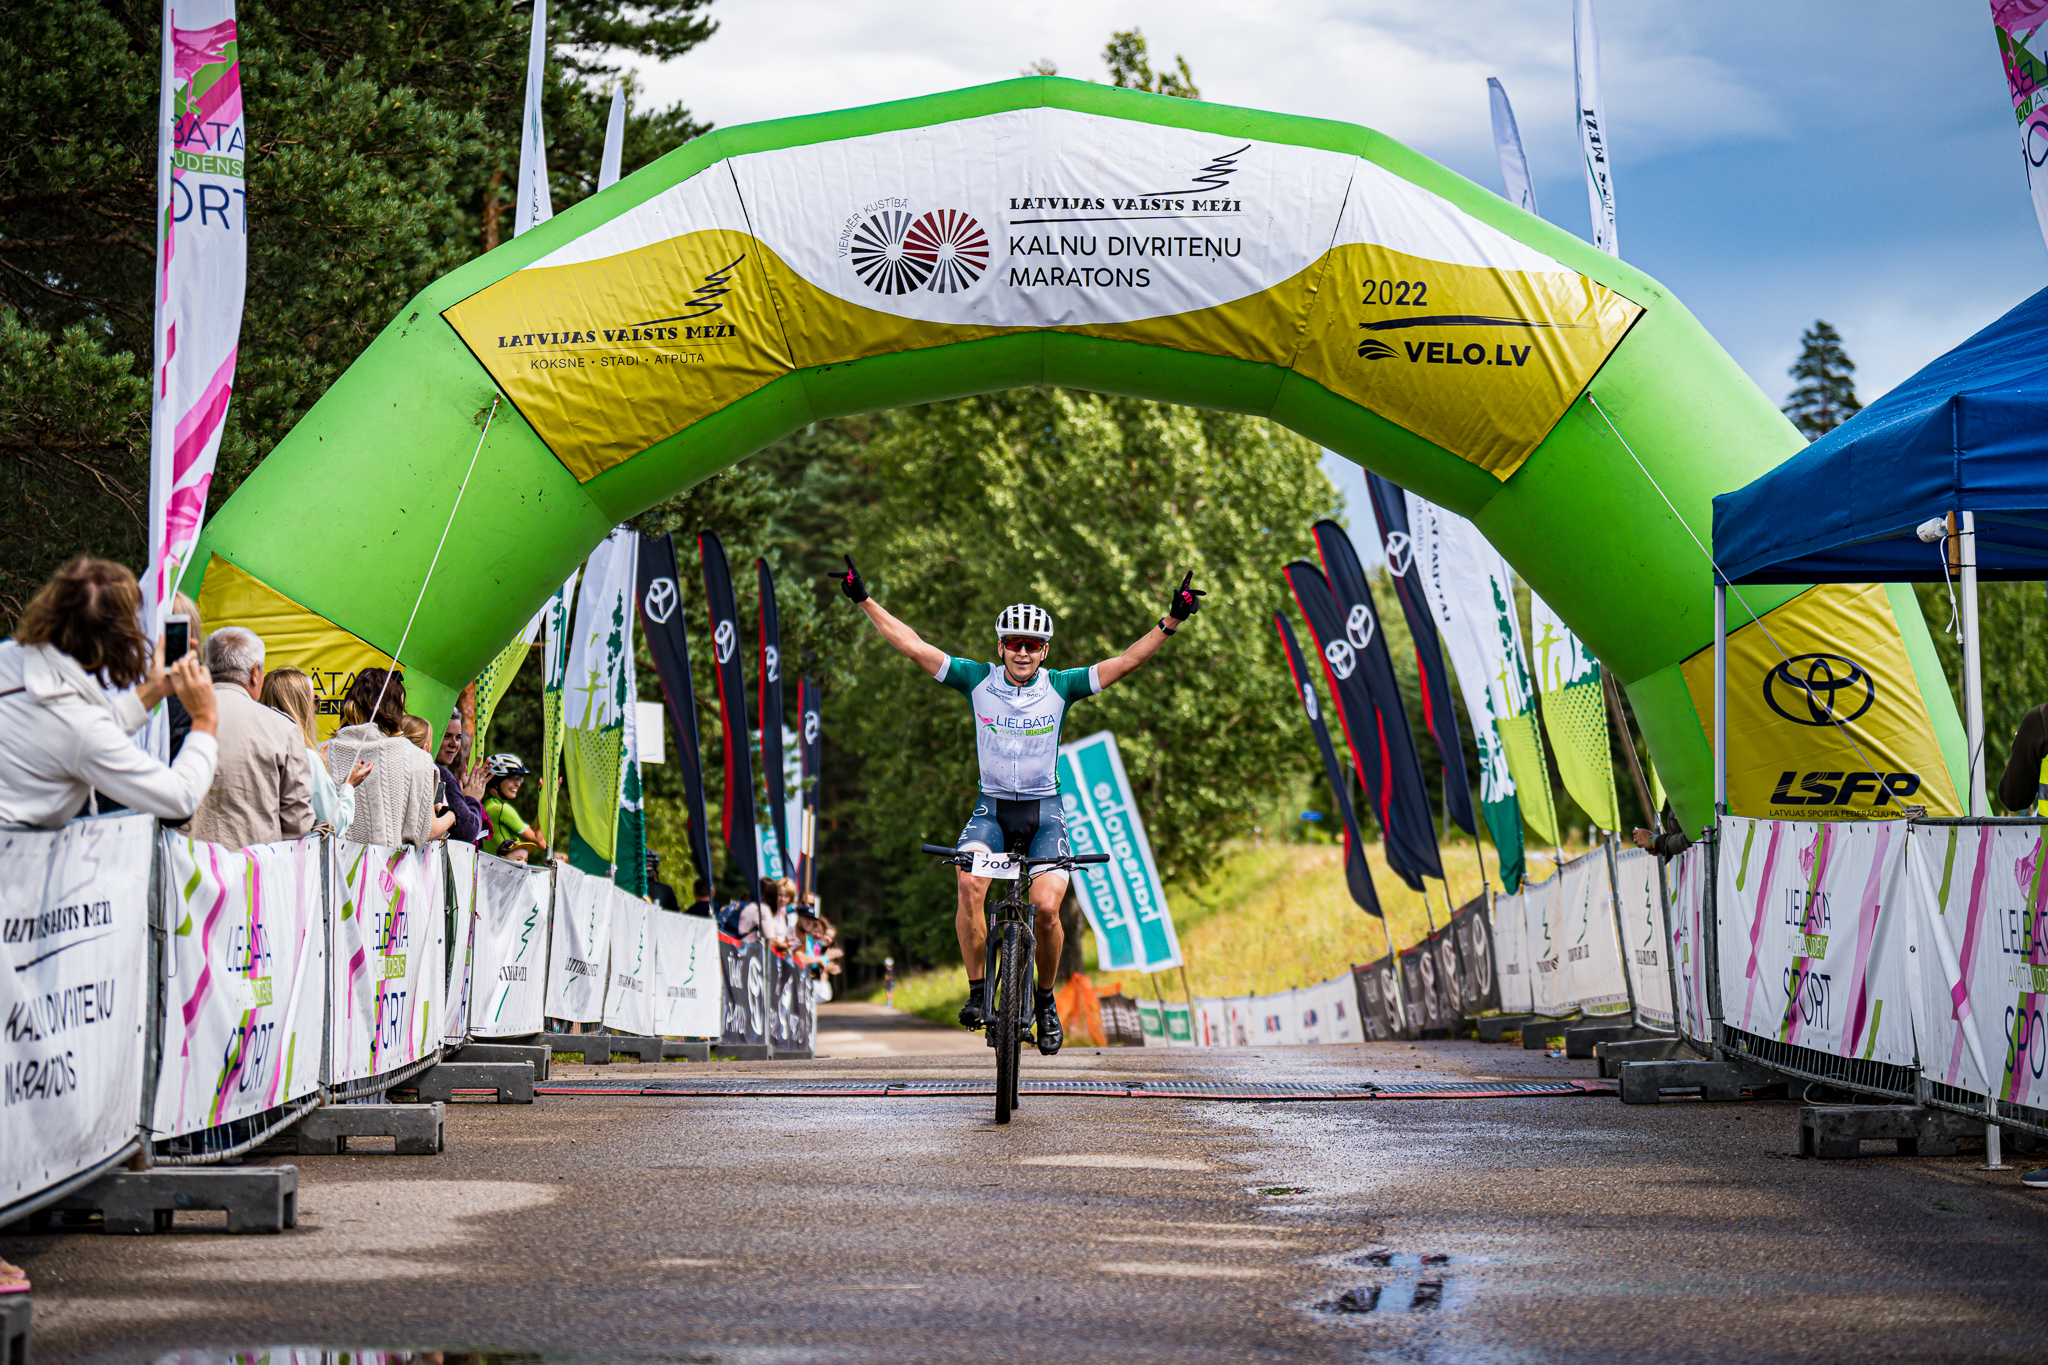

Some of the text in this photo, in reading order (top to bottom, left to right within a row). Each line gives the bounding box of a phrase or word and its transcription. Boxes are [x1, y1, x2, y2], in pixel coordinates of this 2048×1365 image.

[170, 176, 247, 235] ORT
[1009, 195, 1242, 213] LATVIJAS VALSTS MEŽI
[838, 197, 908, 258] VIENMĒR KUSTĪBĀ
[1009, 235, 1242, 263] KALNU DIVRITEŅU
[1009, 267, 1151, 287] MARATONS
[1362, 279, 1428, 306] 2022
[497, 321, 736, 348] LATVIJAS VALSTS MEŽI
[530, 351, 706, 370] KOKSNE STĀDI ATPŪTA
[1403, 341, 1532, 367] VELO.LV
[1769, 771, 1921, 806] LSFP
[1769, 809, 1907, 818] LATVIJAS SPORTA FEDERĀCIJU PAD
[981, 860, 1012, 870] 700
[1783, 967, 1832, 1031] SPORT
